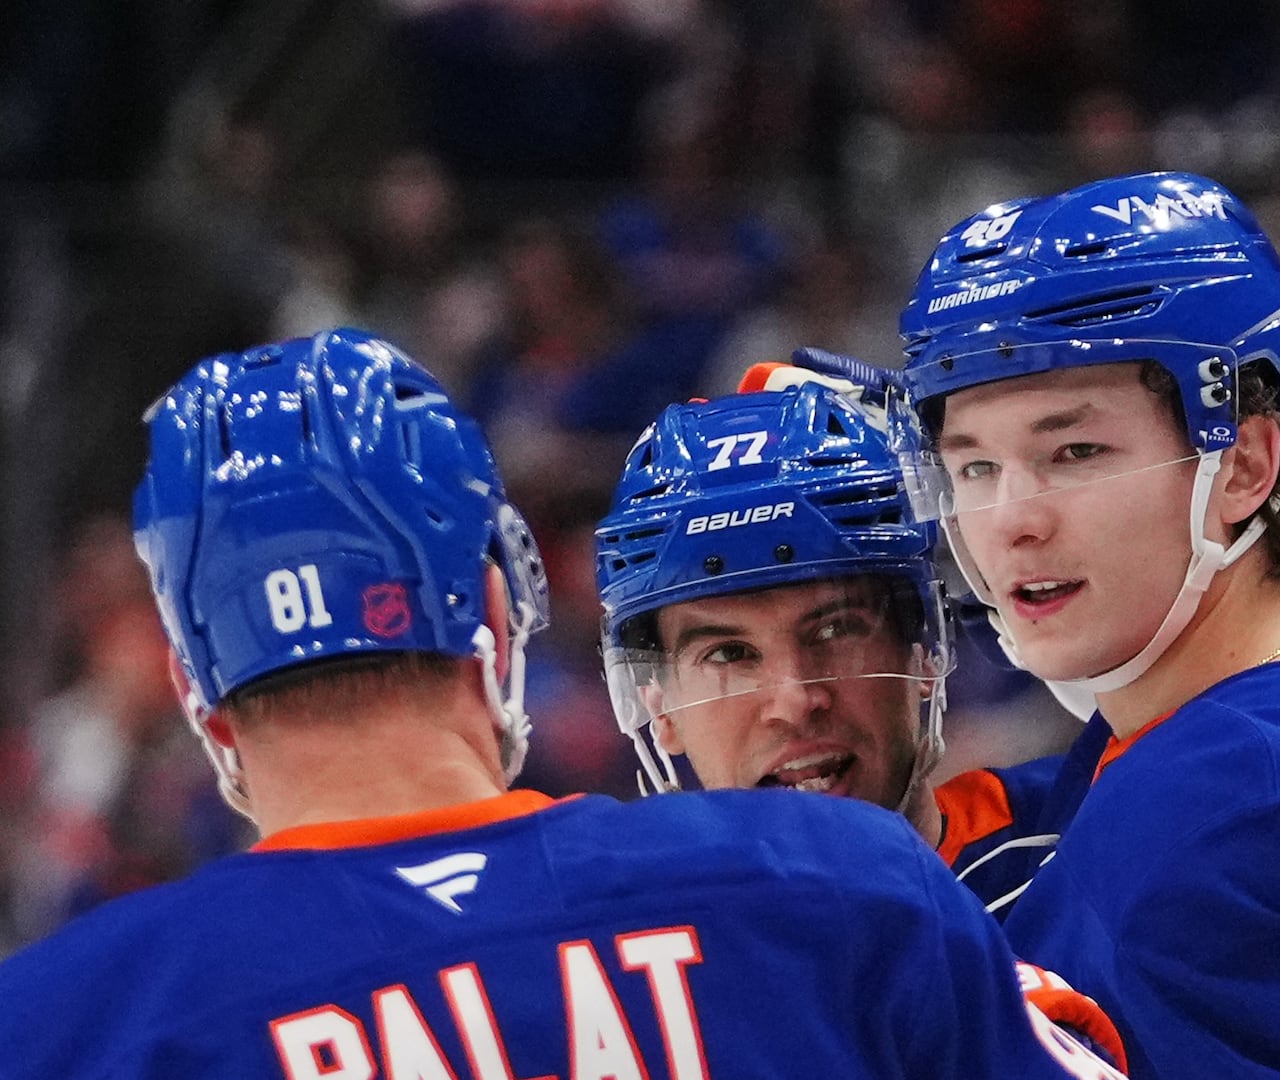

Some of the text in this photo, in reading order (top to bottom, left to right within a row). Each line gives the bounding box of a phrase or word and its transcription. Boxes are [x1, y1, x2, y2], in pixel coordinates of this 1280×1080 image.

[927, 280, 1019, 314] WARRIOR
[707, 431, 768, 471] 77
[686, 502, 795, 535] BAUER
[264, 564, 333, 634] 81
